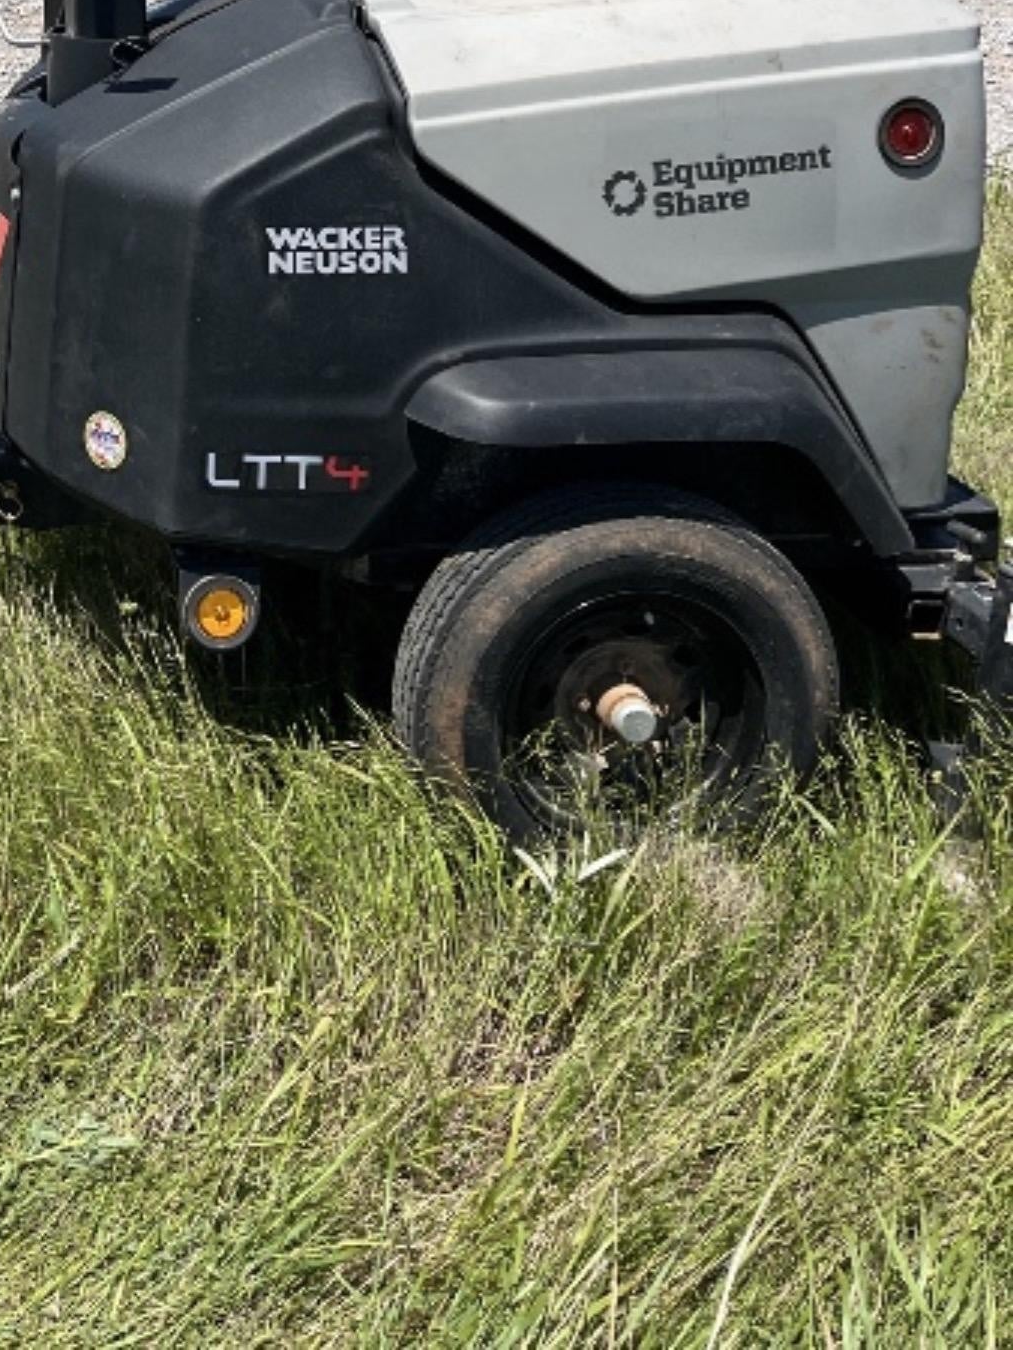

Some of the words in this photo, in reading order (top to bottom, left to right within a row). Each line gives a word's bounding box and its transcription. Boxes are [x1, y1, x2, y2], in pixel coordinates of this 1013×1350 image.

[652, 144, 832, 190] Equipment
[653, 188, 751, 218] Share
[265, 226, 408, 250] WACKER
[268, 251, 408, 274] NEUSON
[206, 452, 370, 490] LTT4
